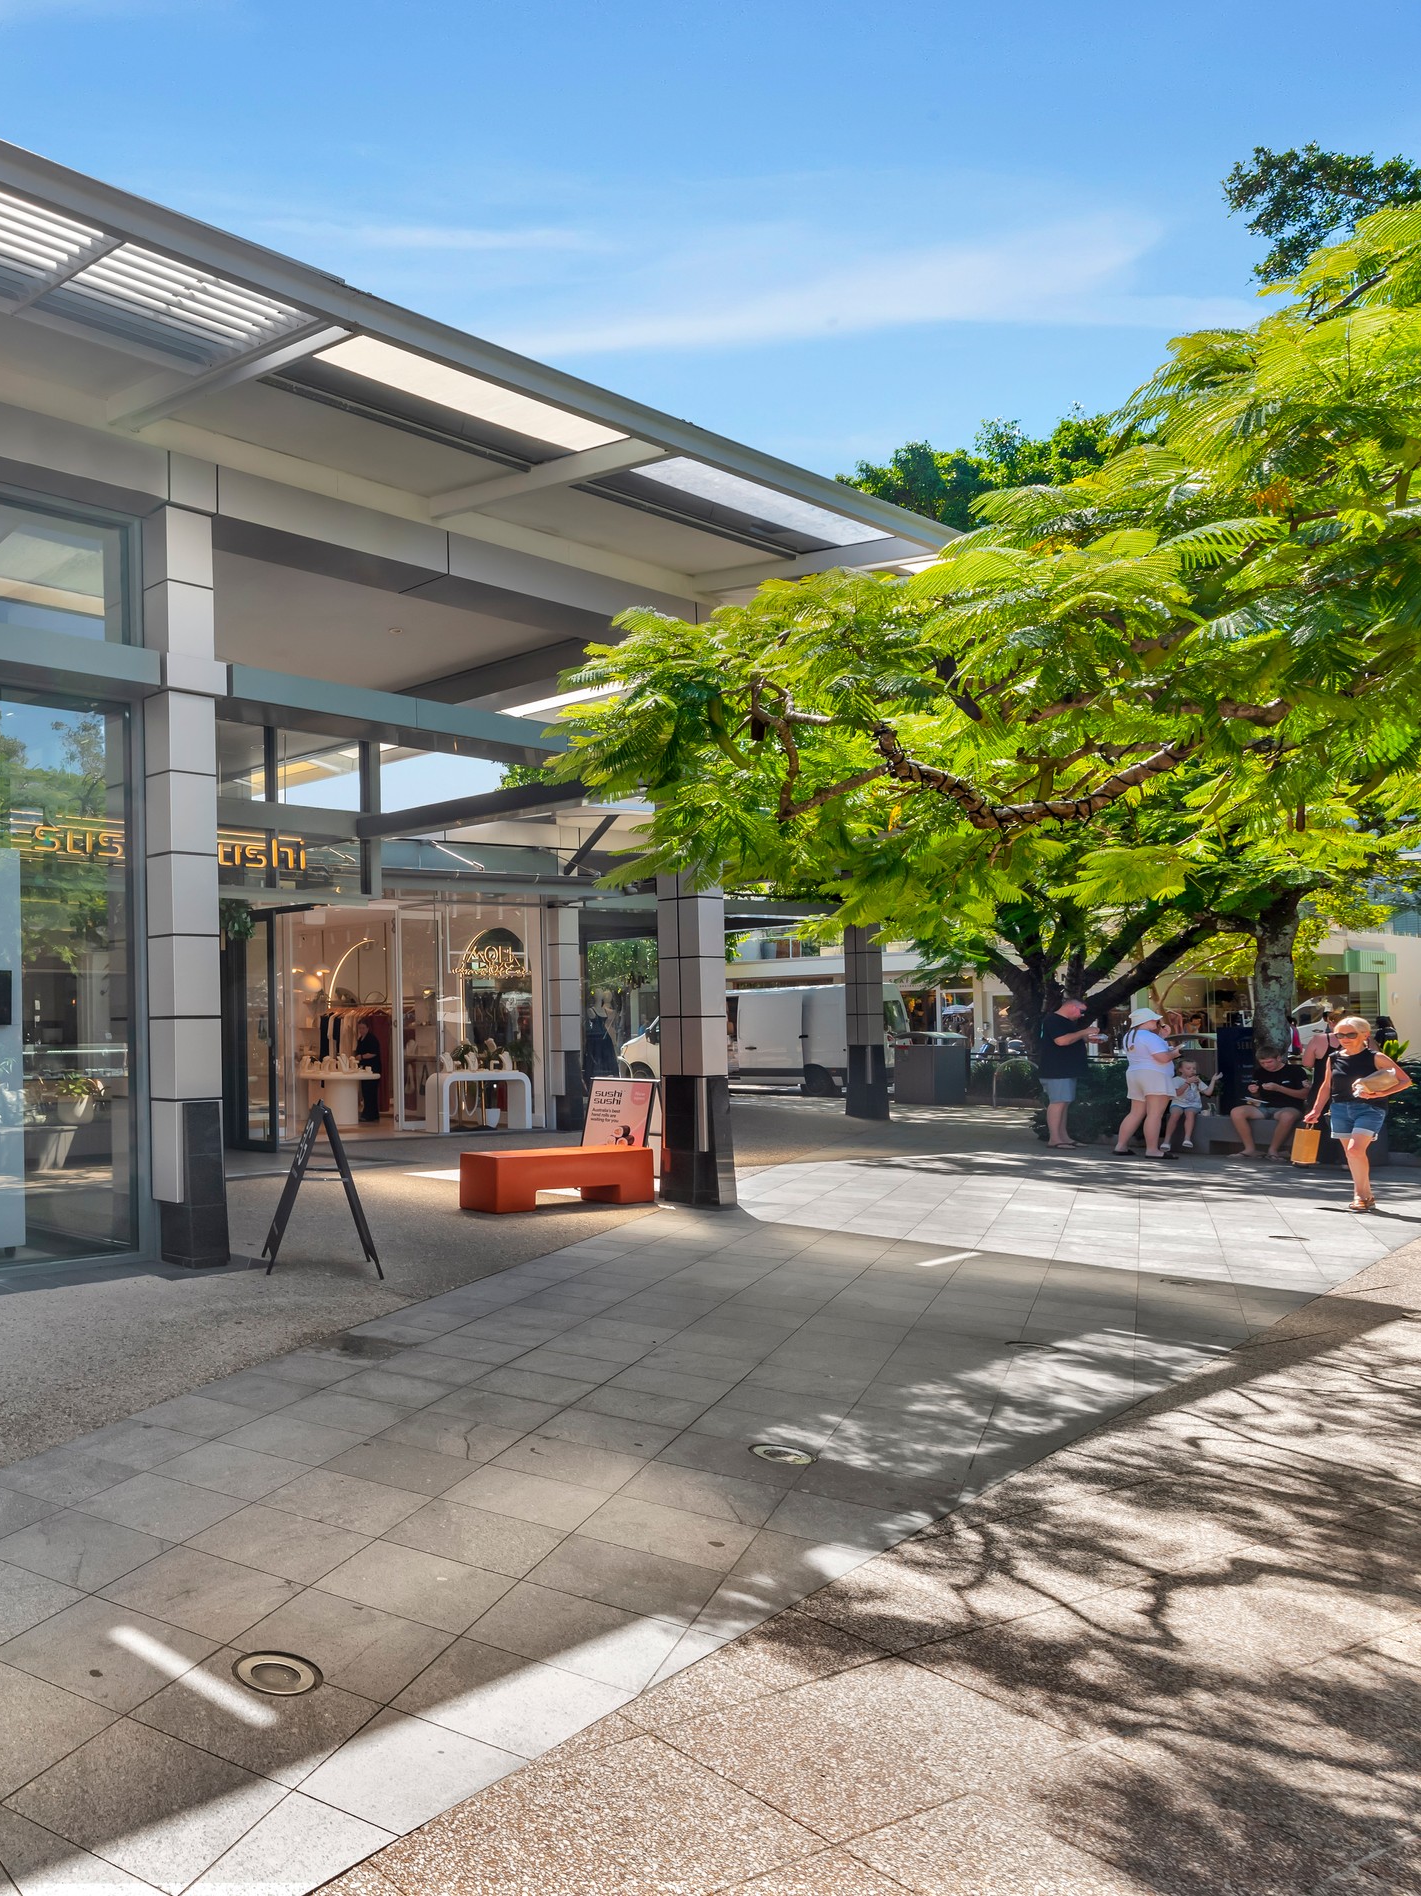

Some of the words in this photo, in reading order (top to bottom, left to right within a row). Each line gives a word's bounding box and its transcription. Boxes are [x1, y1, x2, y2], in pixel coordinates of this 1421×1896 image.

[34, 825, 125, 858] sus
[217, 838, 306, 871] ushi
[595, 1090, 623, 1098] sushi
[593, 1097, 622, 1105] sushi
